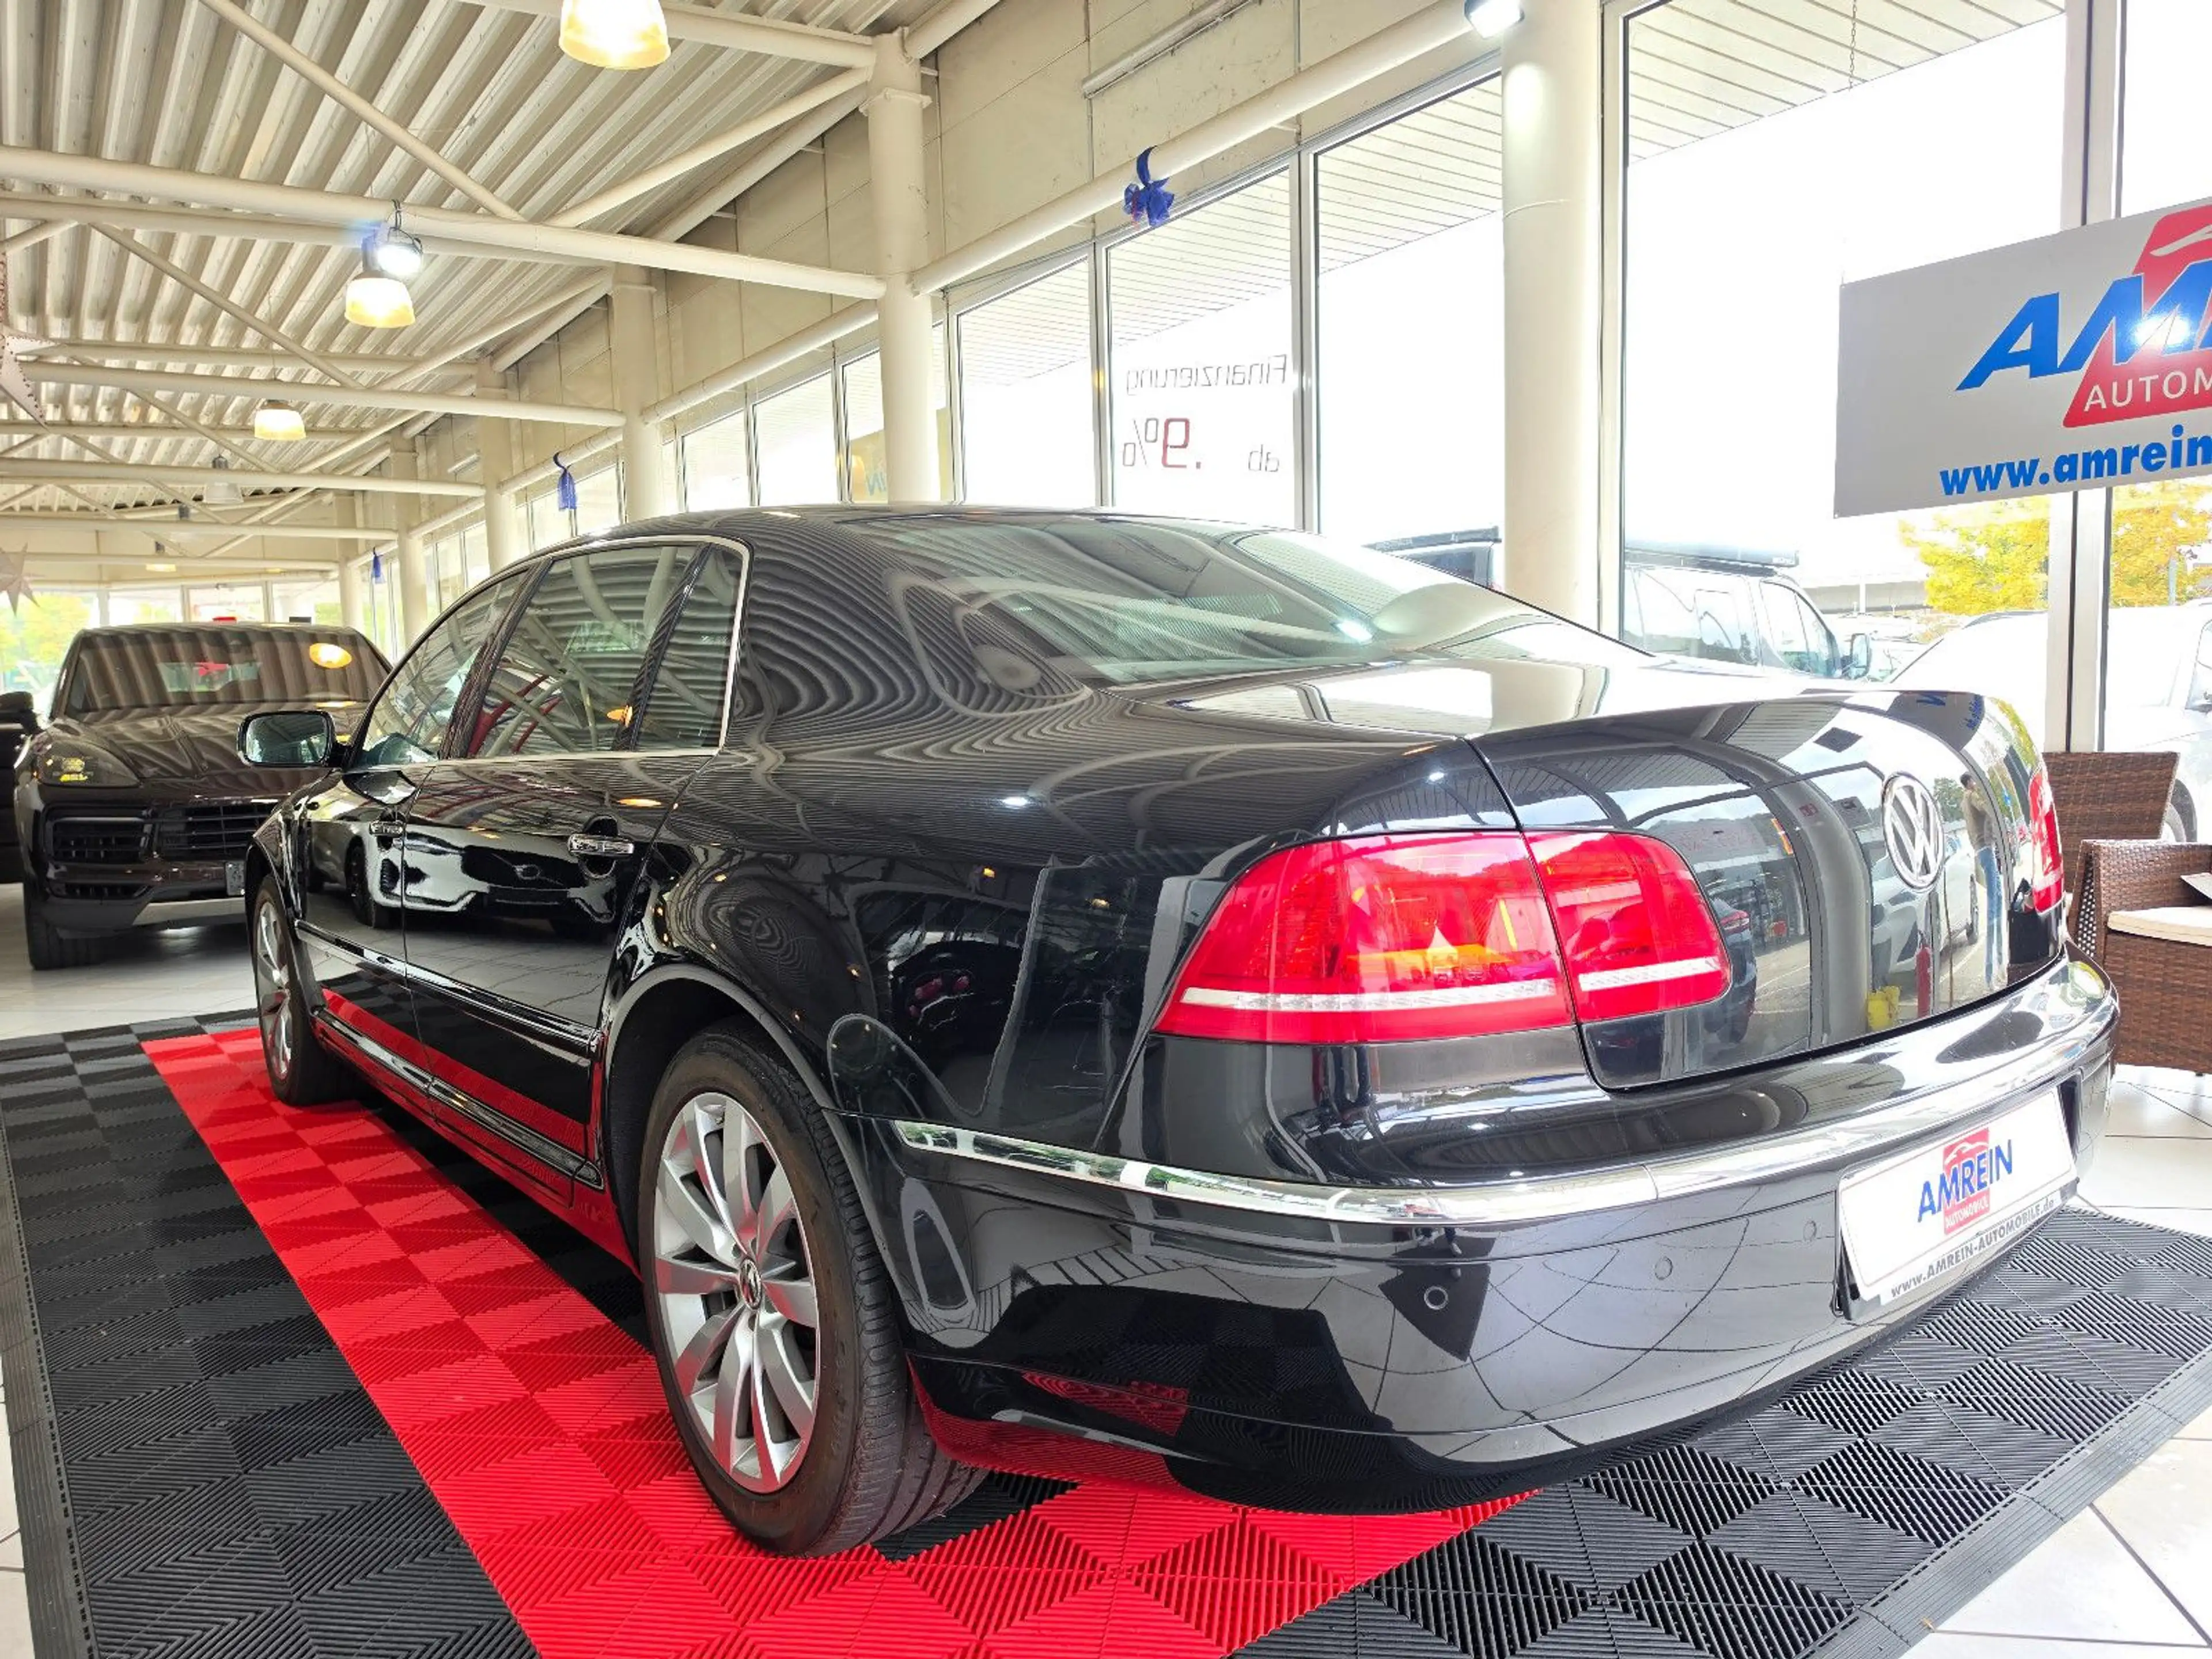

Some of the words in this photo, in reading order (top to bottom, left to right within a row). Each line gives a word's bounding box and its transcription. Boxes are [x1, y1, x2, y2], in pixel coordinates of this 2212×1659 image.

[1955, 259, 2212, 392] AM
[1940, 424, 2212, 496] www.amrein
[1918, 1139, 2012, 1222] AMREIN
[1891, 1196, 2055, 1298] www.AMREIN-AUTOMOBILE.de
